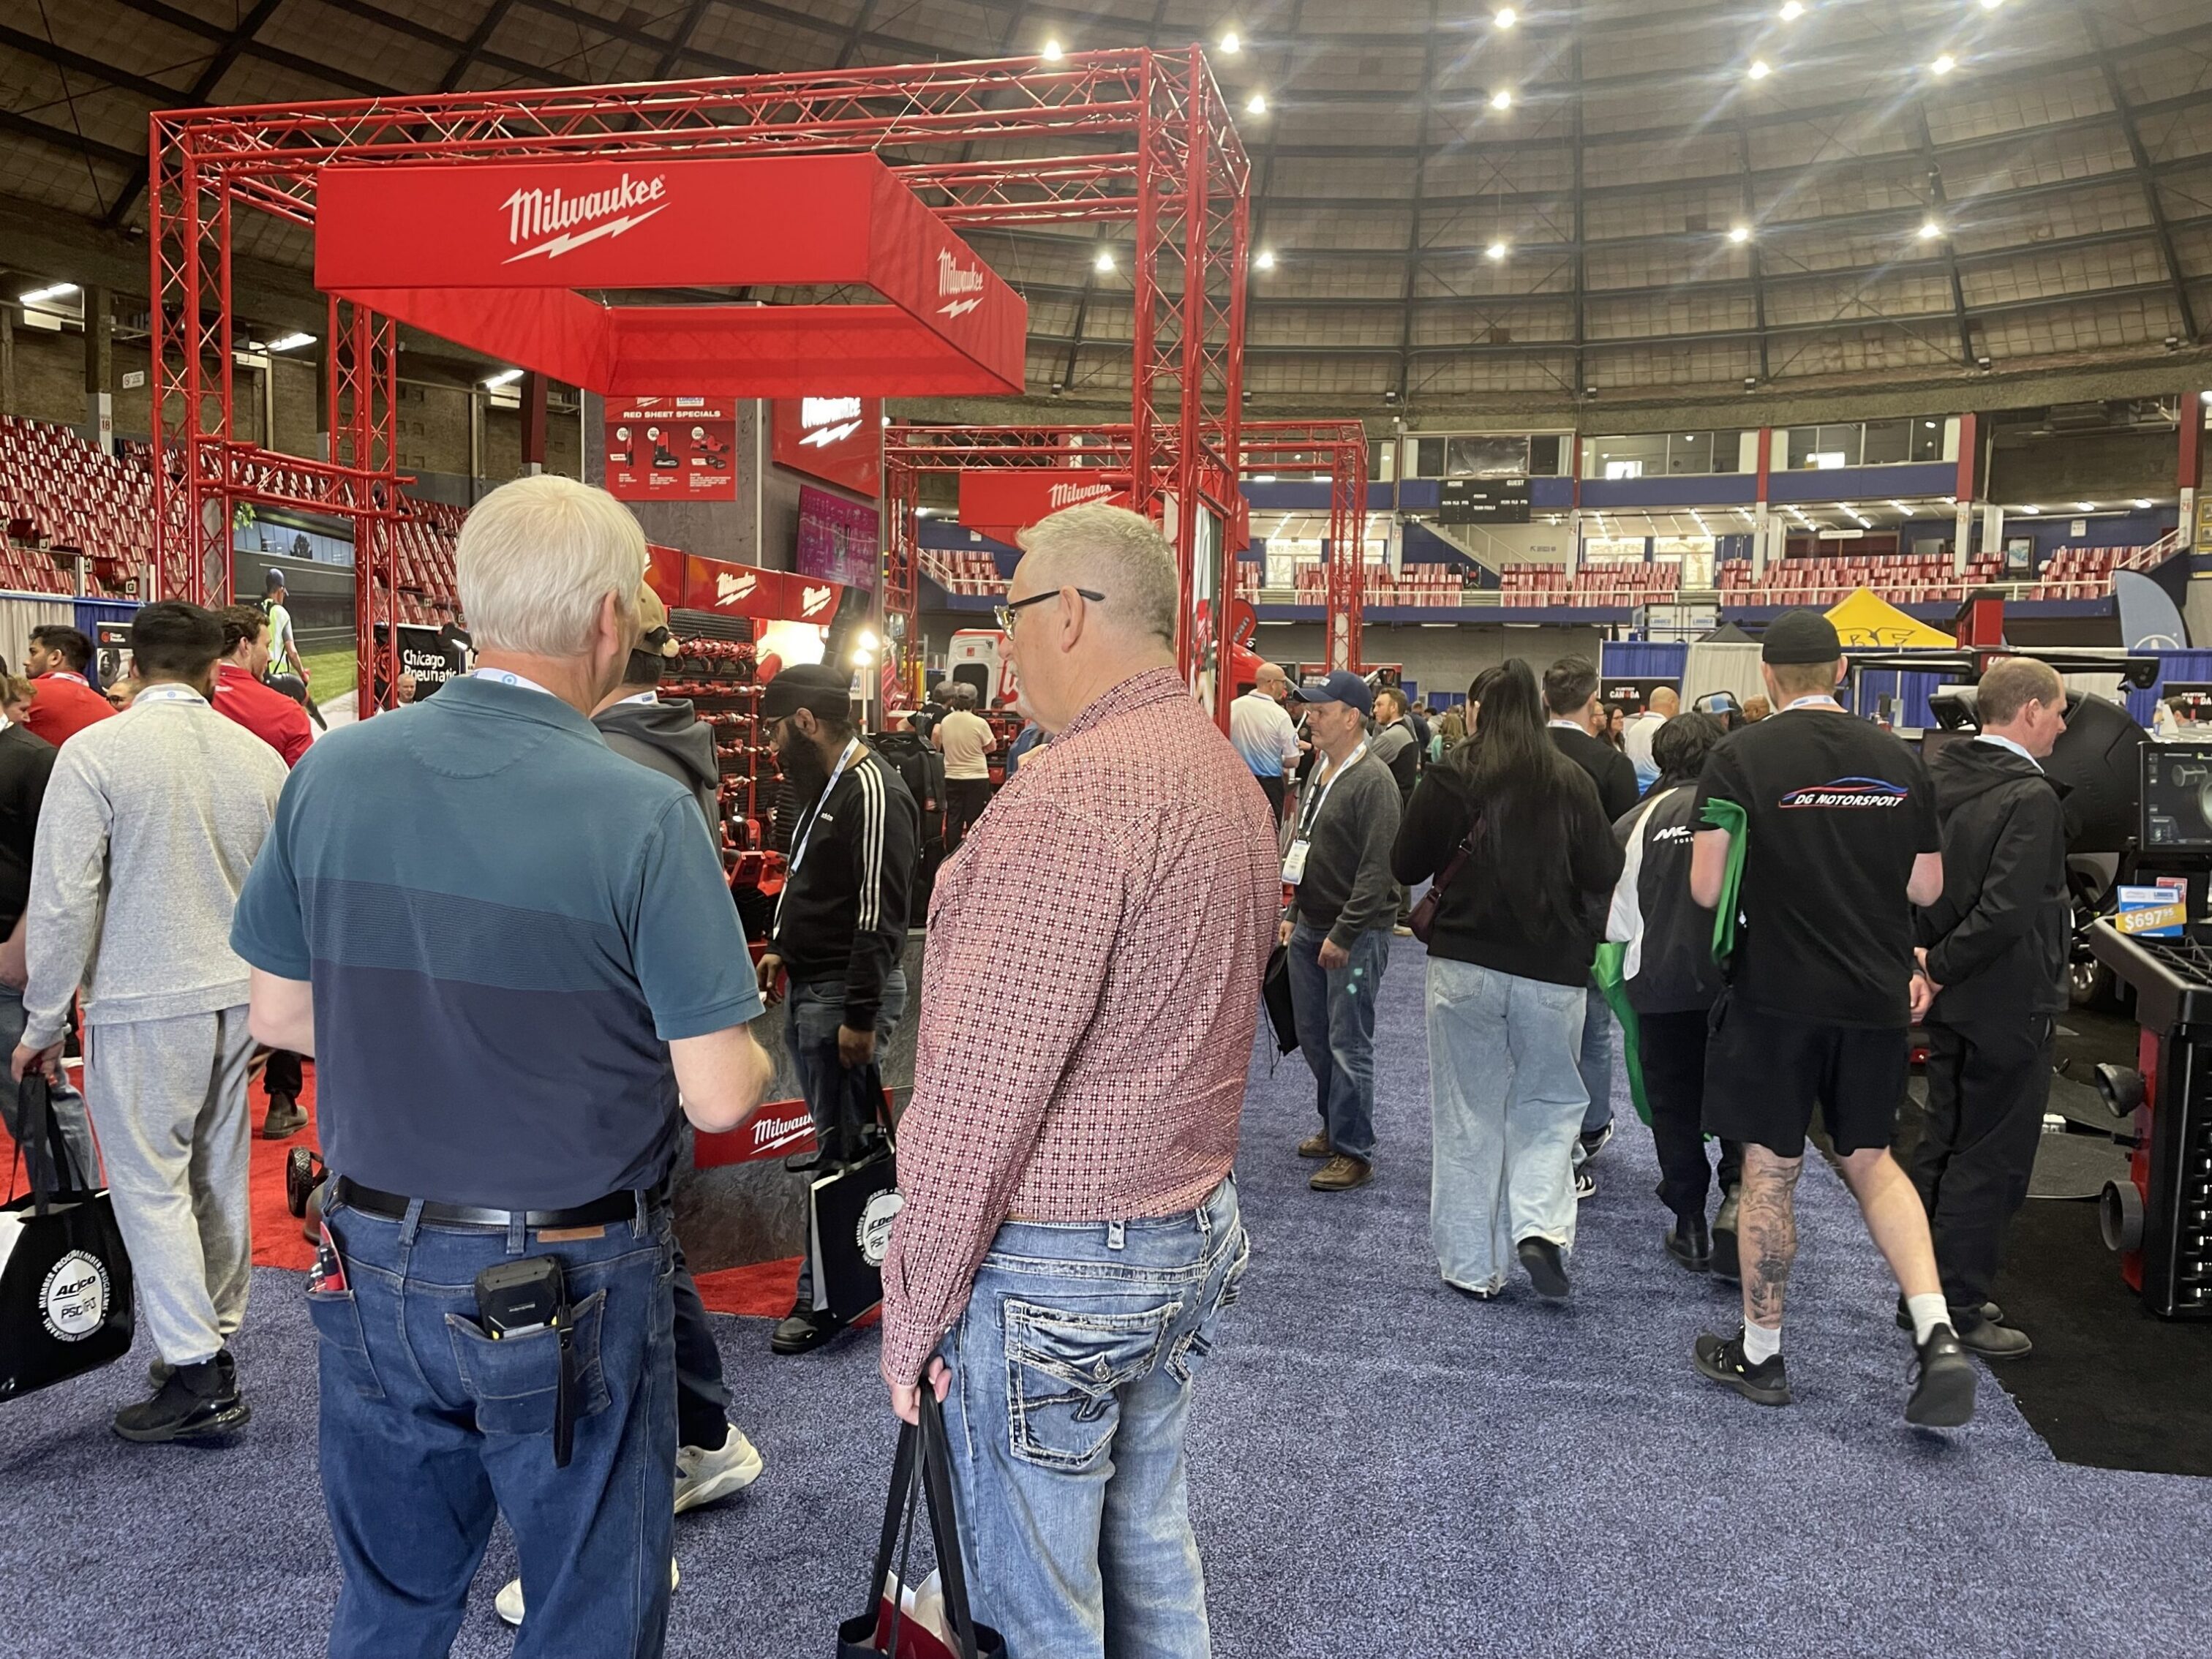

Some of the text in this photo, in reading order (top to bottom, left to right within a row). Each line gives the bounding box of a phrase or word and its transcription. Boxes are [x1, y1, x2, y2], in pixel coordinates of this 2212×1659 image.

[498, 173, 666, 245] Milwaukee
[937, 247, 983, 298] Milwaukee
[644, 410, 674, 418] SHEET
[676, 410, 721, 418] SPECIALS
[102, 420, 110, 430] 18
[41, 541, 48, 549] J
[85, 563, 91, 572] H
[127, 583, 135, 592] G
[404, 649, 445, 669] Chicago
[1794, 794, 1904, 808] DG MOTORSPORT
